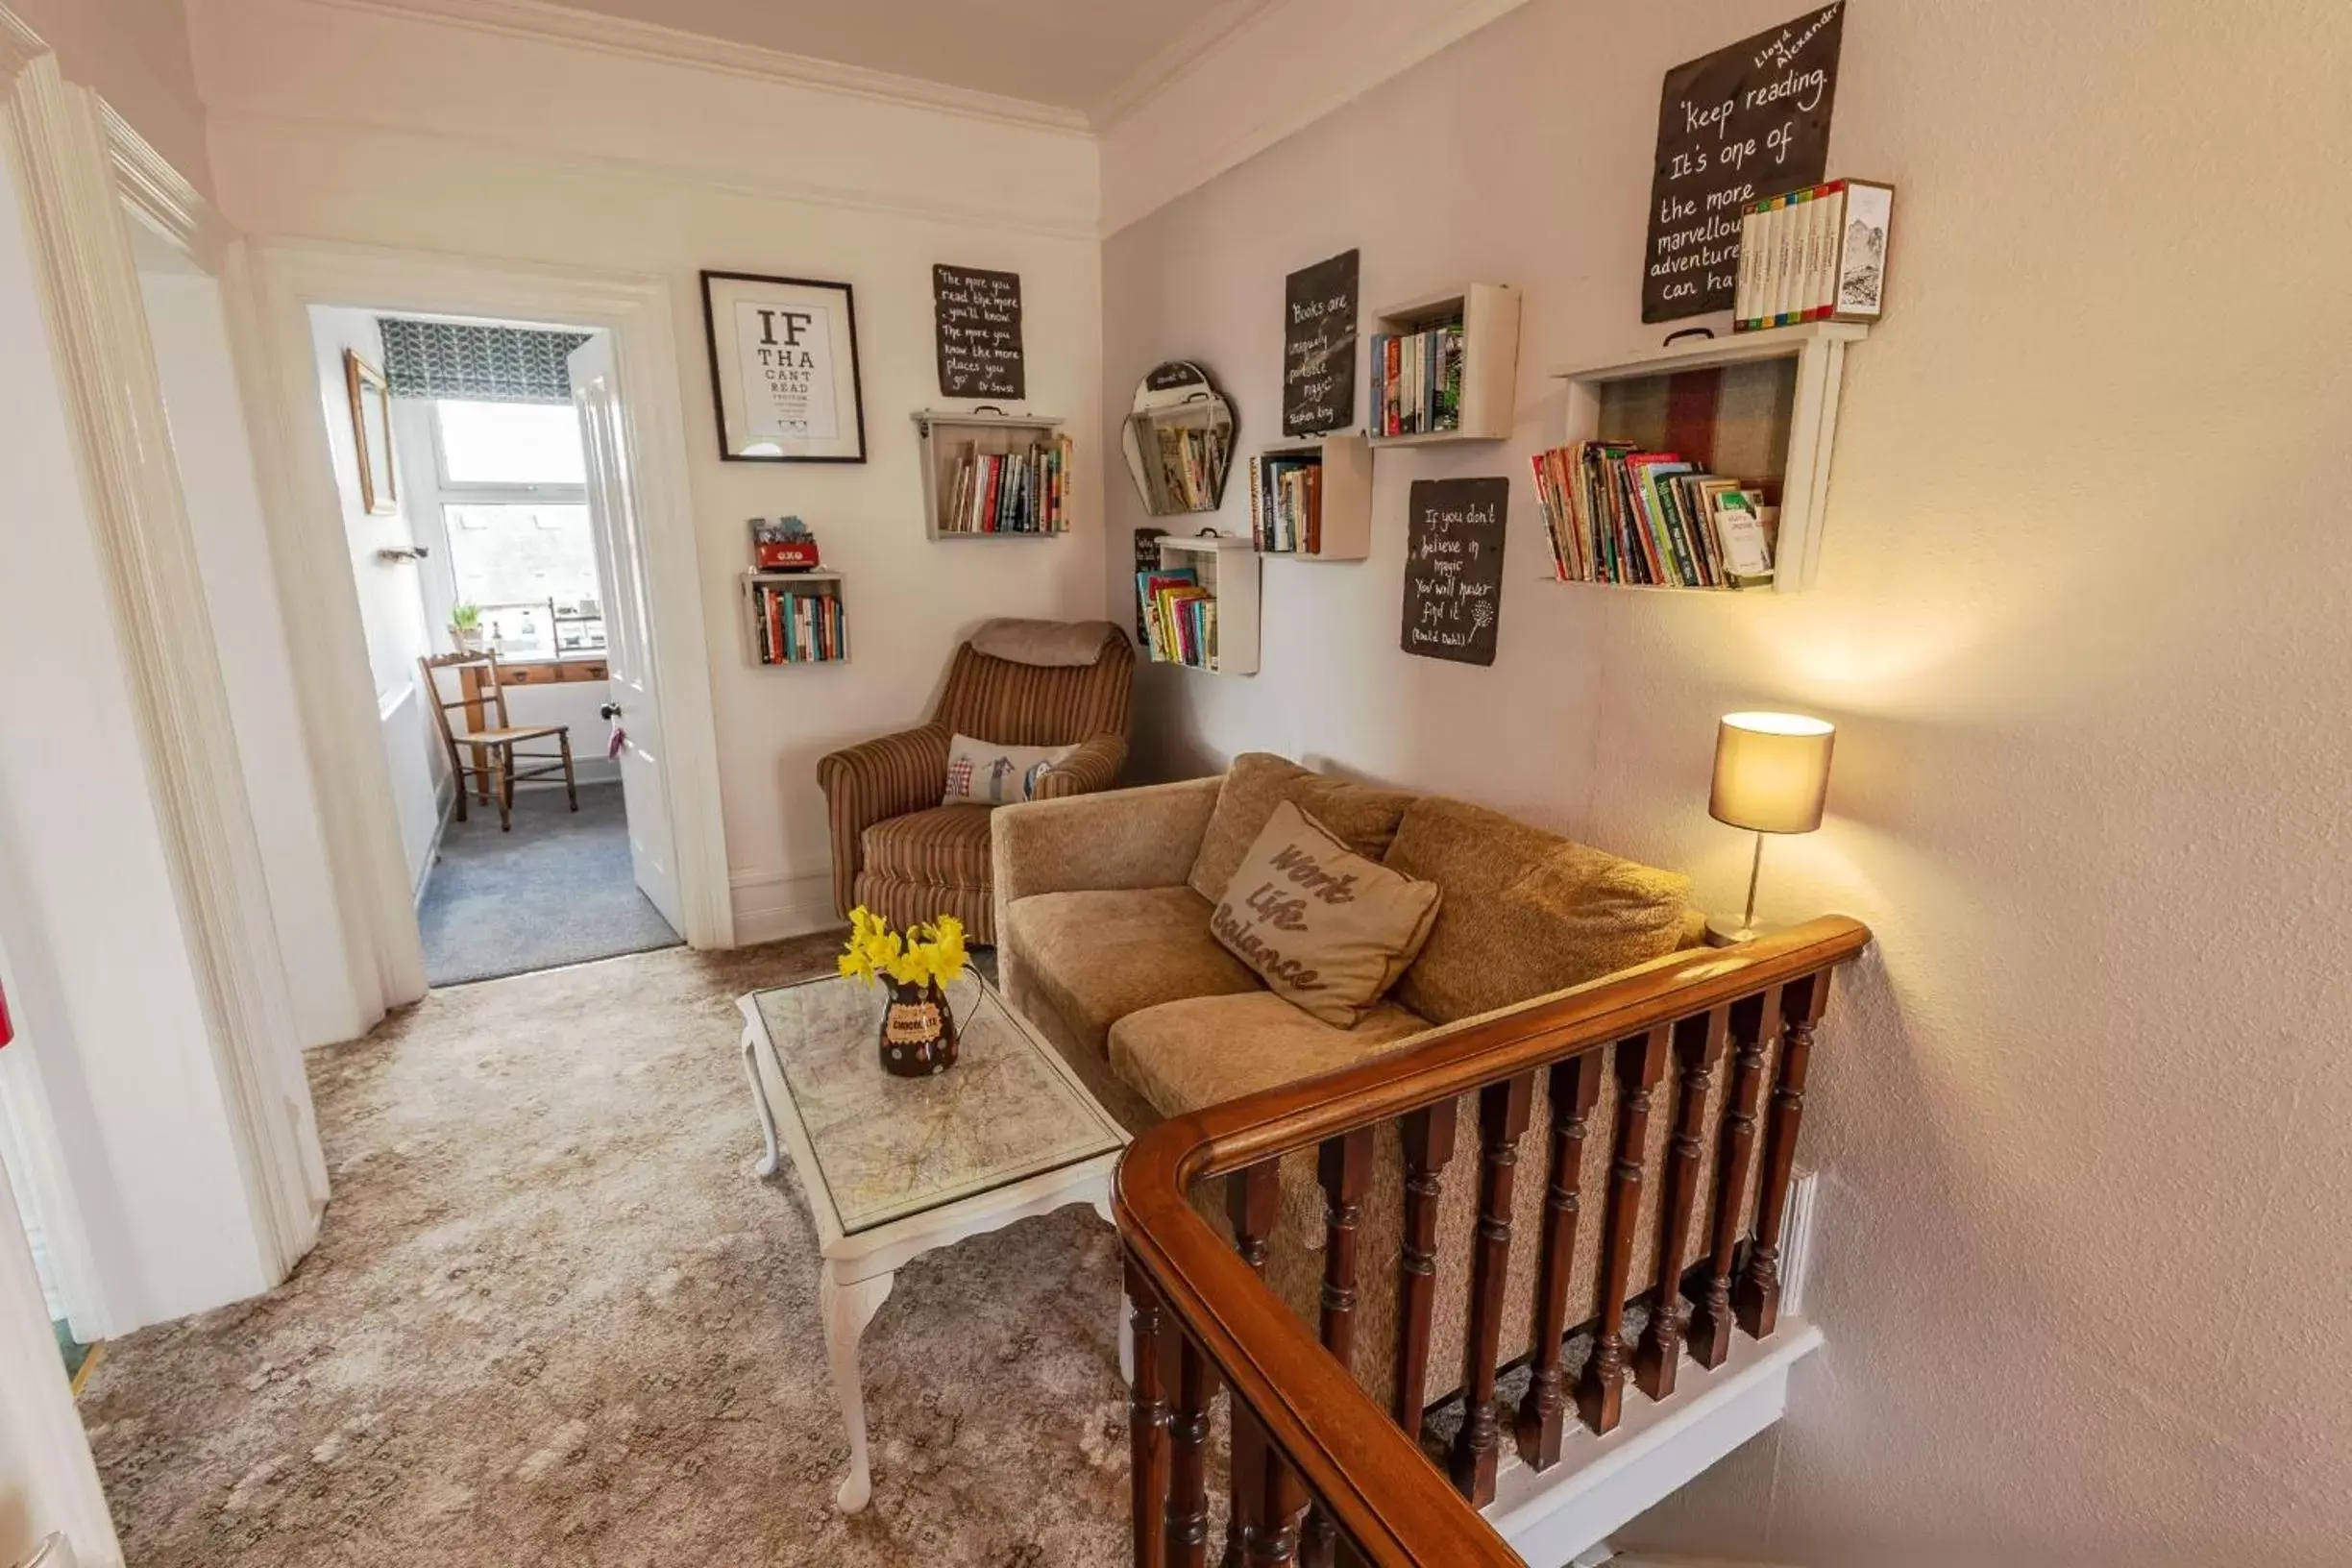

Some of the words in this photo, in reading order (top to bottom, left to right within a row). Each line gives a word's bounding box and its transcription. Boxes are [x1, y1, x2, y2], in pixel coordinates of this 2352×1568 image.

[1754, 29, 1792, 68] Lloyd
[1776, 5, 1839, 68] Alexander
[1670, 144, 1707, 180] It's
[1720, 138, 1756, 170] one
[1767, 121, 1793, 164] of
[1661, 195, 1697, 224] the
[1706, 184, 1755, 210] more
[1657, 213, 1741, 256] marvellou
[1650, 244, 1740, 277] adventure
[990, 280, 1011, 297] you
[1662, 282, 1697, 301] can
[1707, 271, 1733, 290] ha
[942, 289, 968, 303] read
[973, 291, 992, 307] the
[993, 297, 1018, 312] more
[757, 309, 812, 346] IF
[943, 324, 962, 339] The
[965, 329, 989, 344] more
[992, 331, 1011, 346] you
[757, 349, 815, 369] THA
[971, 345, 991, 357] the
[994, 349, 1019, 359] more
[946, 356, 980, 376] places
[985, 363, 1004, 379] you
[771, 382, 808, 392] READ
[1425, 508, 1438, 531] If
[1441, 511, 1462, 532] you
[1421, 534, 1460, 560] believe
[1468, 540, 1480, 561] in
[1433, 560, 1463, 577] magic
[1435, 576, 1456, 596] will
[1459, 582, 1493, 606] never
[1421, 601, 1445, 626] find
[1450, 601, 1459, 620] it
